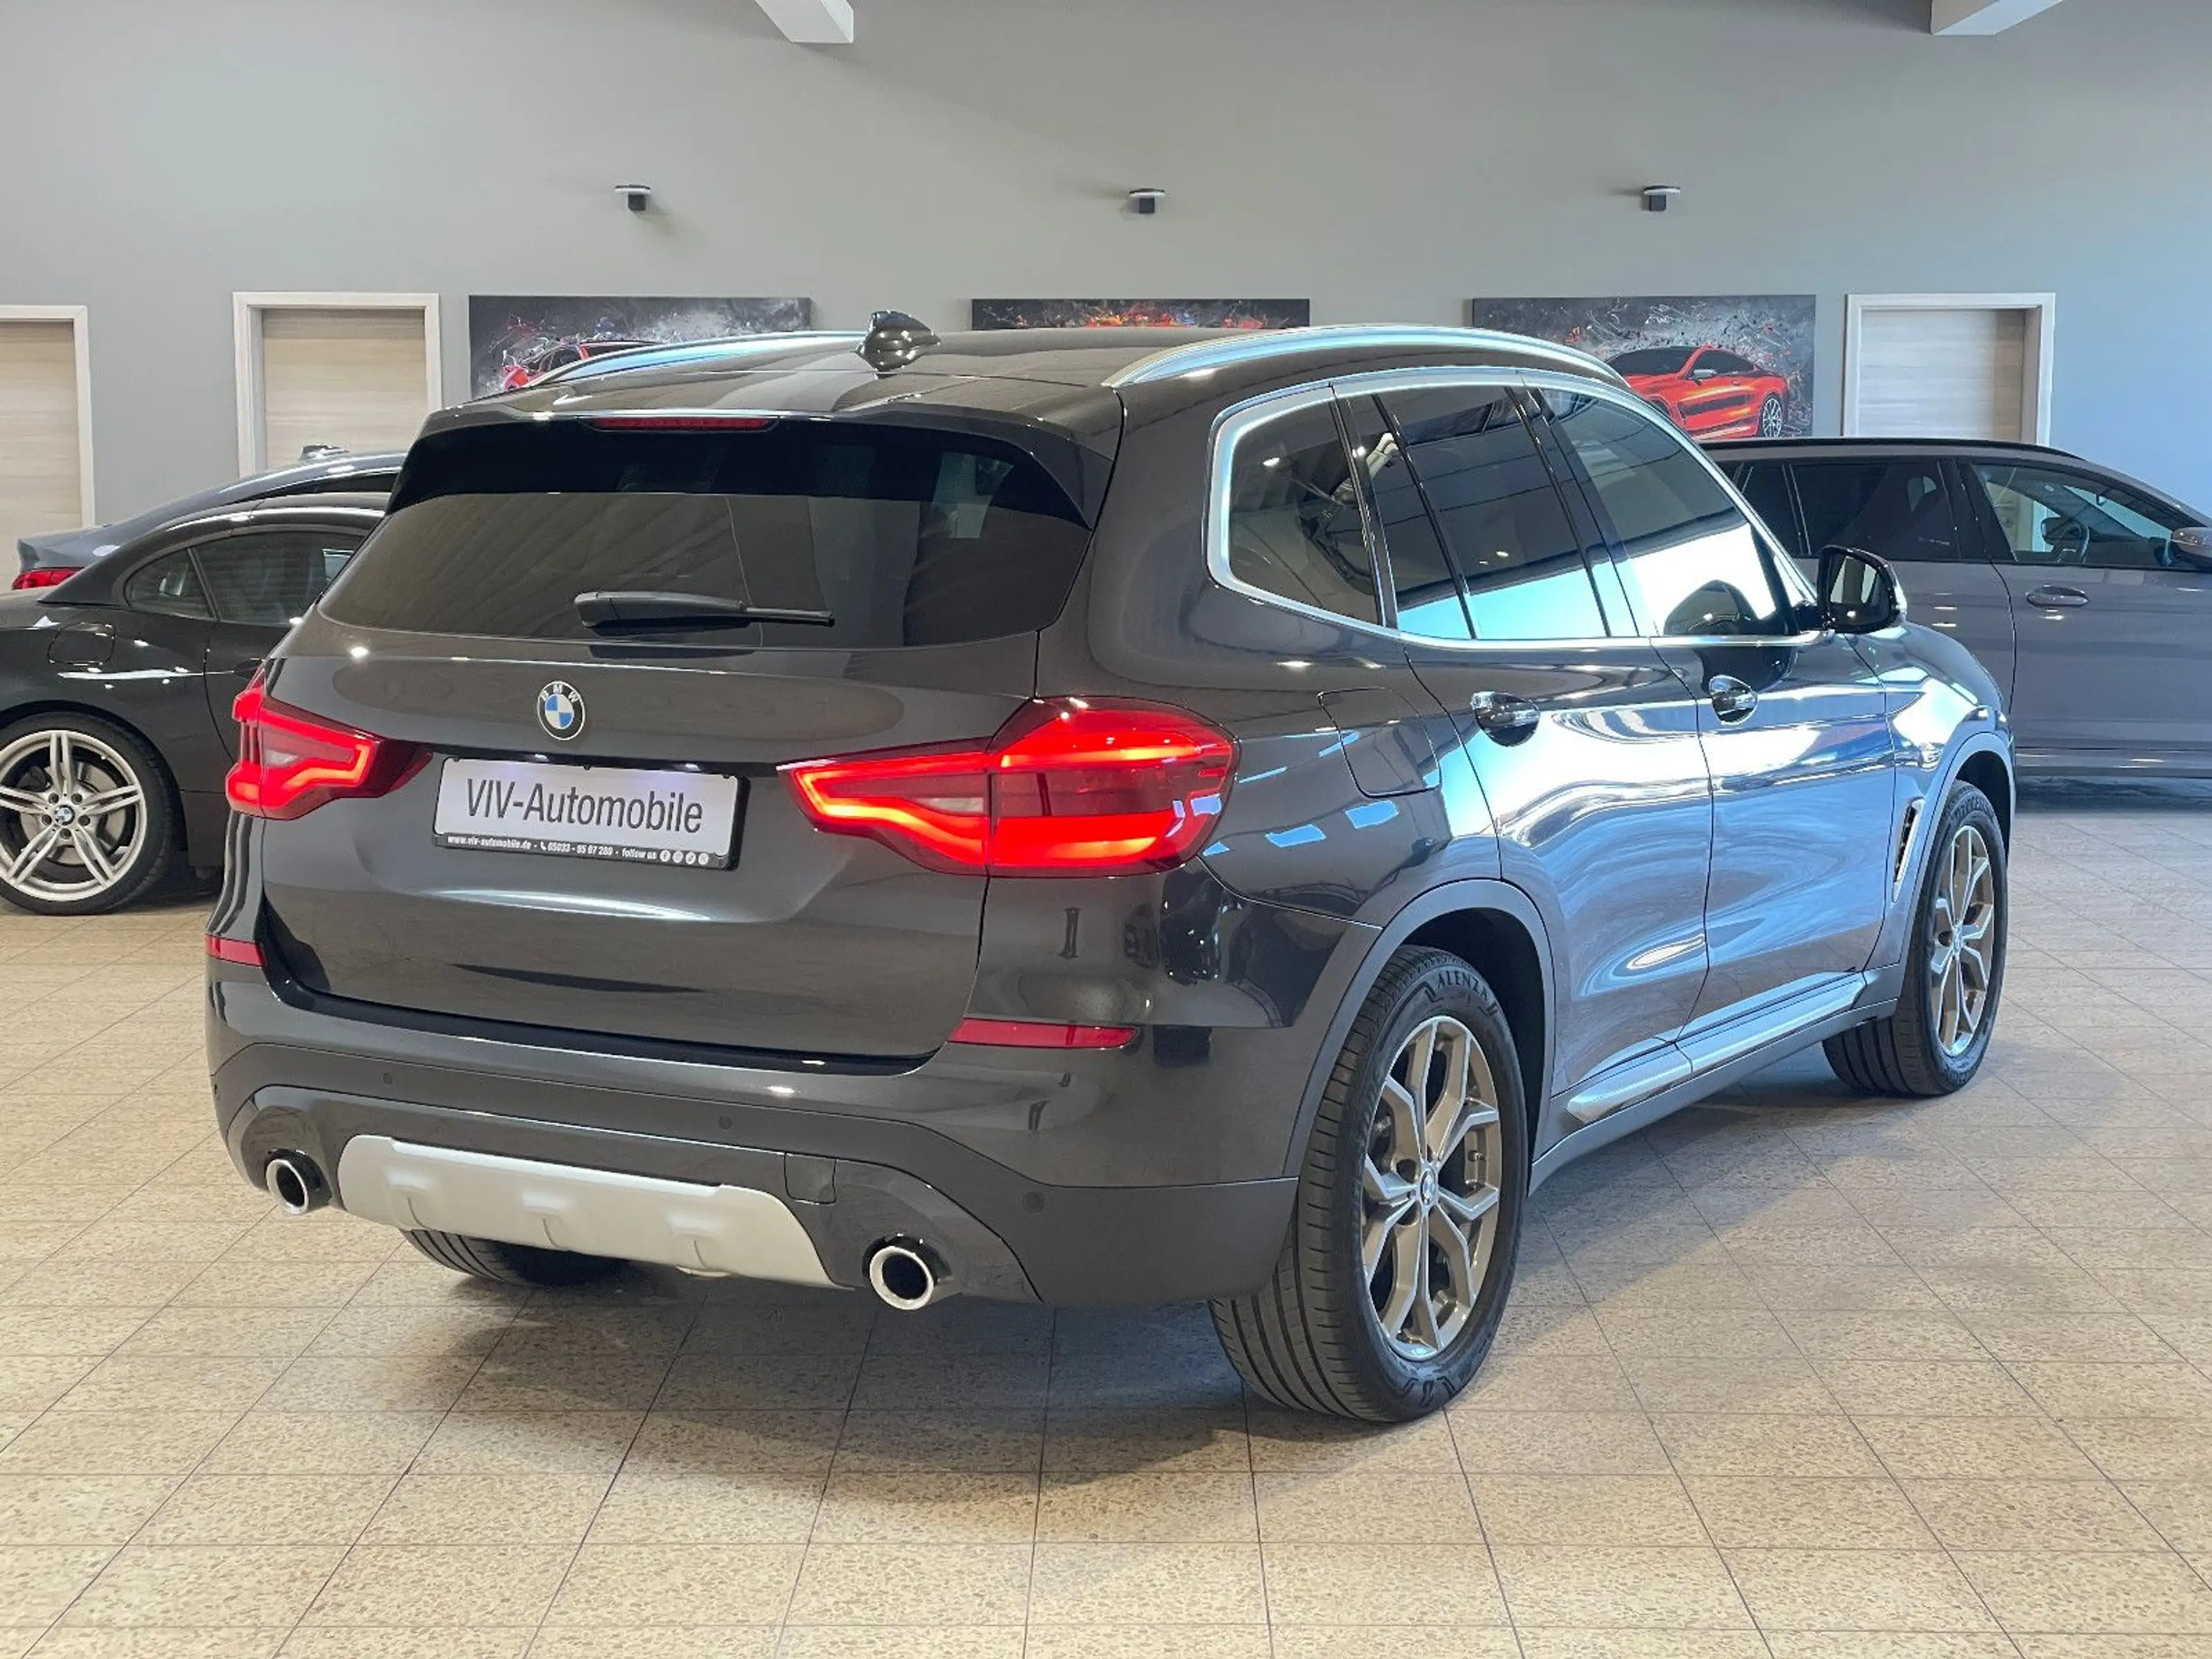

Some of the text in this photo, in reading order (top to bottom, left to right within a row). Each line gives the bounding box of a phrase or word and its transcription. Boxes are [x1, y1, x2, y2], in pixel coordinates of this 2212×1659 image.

[467, 778, 703, 834] VIV-Automobile
[448, 836, 531, 850] www.viv-automobile.de
[1437, 970, 1488, 1001] ALENZA
